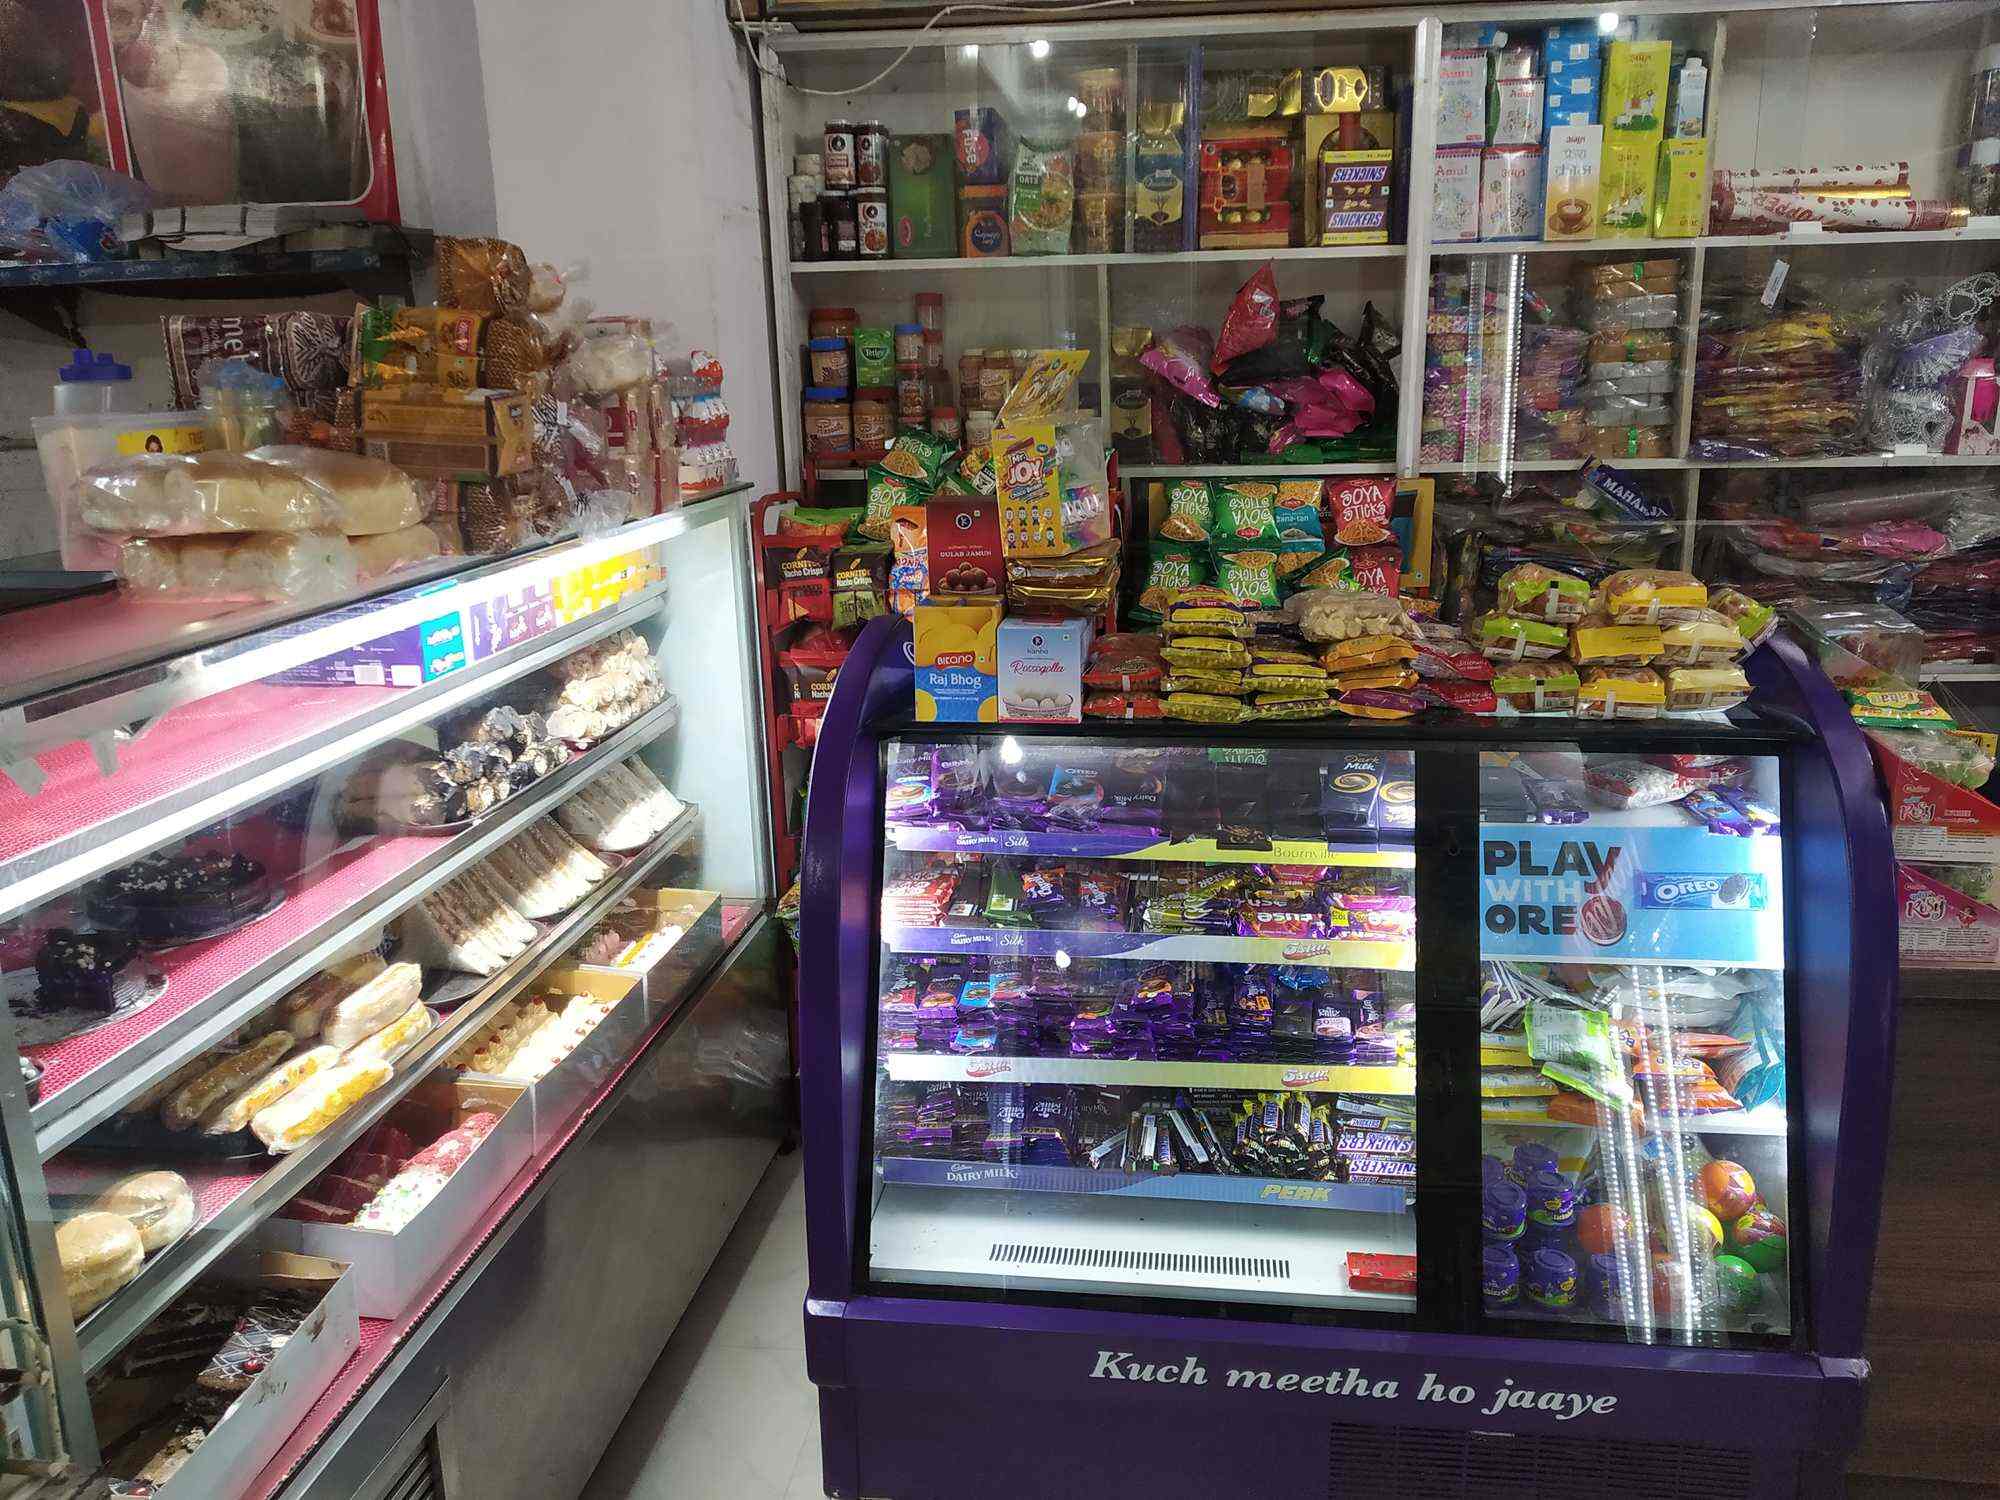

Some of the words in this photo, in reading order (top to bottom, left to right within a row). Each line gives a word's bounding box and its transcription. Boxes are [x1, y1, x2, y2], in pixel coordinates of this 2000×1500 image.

[1329, 212, 1383, 228] SNICKERS
[1171, 487, 1209, 501] SOYA
[1341, 486, 1383, 506] SOYA
[1343, 501, 1386, 521] STICKS
[929, 673, 949, 687] Raj
[951, 674, 983, 690] Bhog
[1004, 835, 1031, 848] Silk
[1483, 841, 1622, 886] PLAY
[1485, 879, 1584, 902] WITH
[1655, 879, 1720, 904] OREO
[1000, 934, 1025, 946] Silk
[947, 1170, 983, 1182] DAIRY
[983, 1168, 1018, 1179] MILK
[1261, 1184, 1333, 1201] PERK
[1089, 1351, 1208, 1385] Kuch
[1226, 1367, 1399, 1399] meetha
[1416, 1373, 1477, 1405] ho
[1481, 1379, 1619, 1421] jaaye
